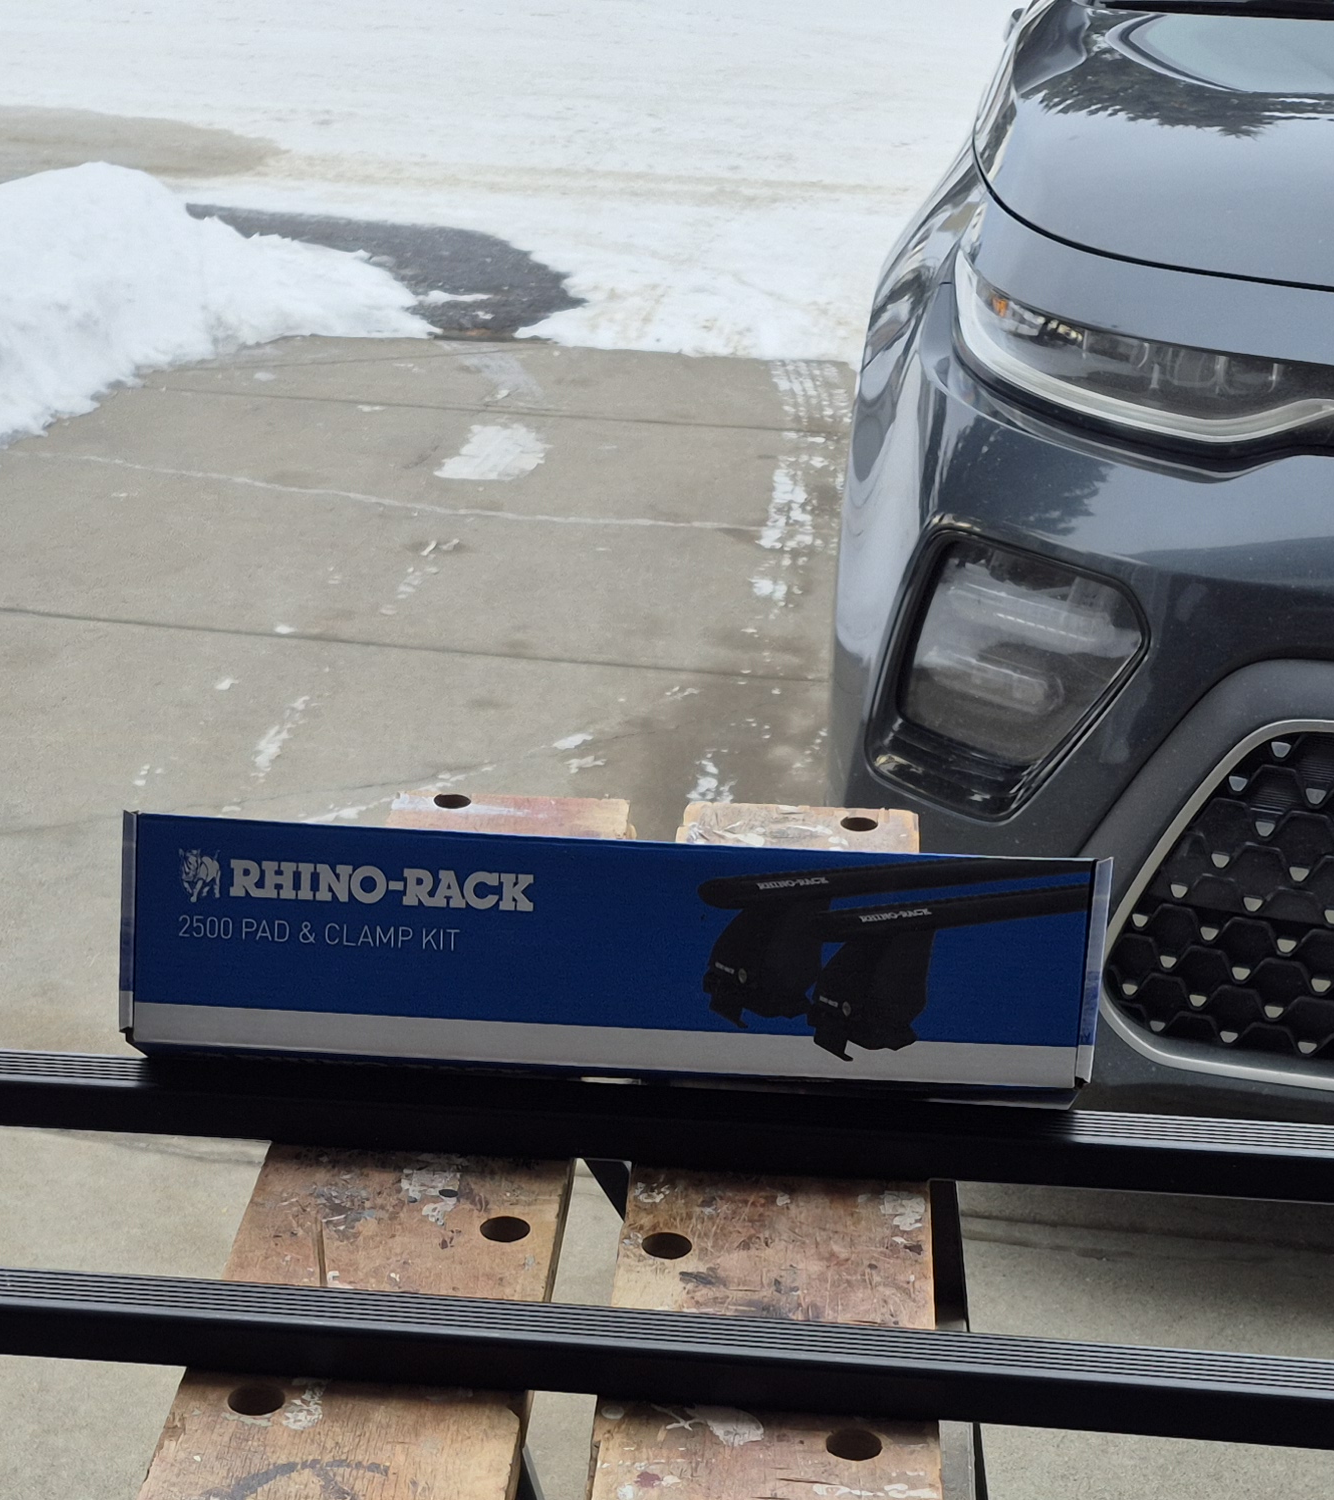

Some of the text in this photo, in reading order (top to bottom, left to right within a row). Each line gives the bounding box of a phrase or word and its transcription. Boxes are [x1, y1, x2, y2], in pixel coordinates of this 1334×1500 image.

[229, 858, 534, 912] RHINO-RACK
[178, 915, 461, 952] 2500 PAD & CLAMP KIT
